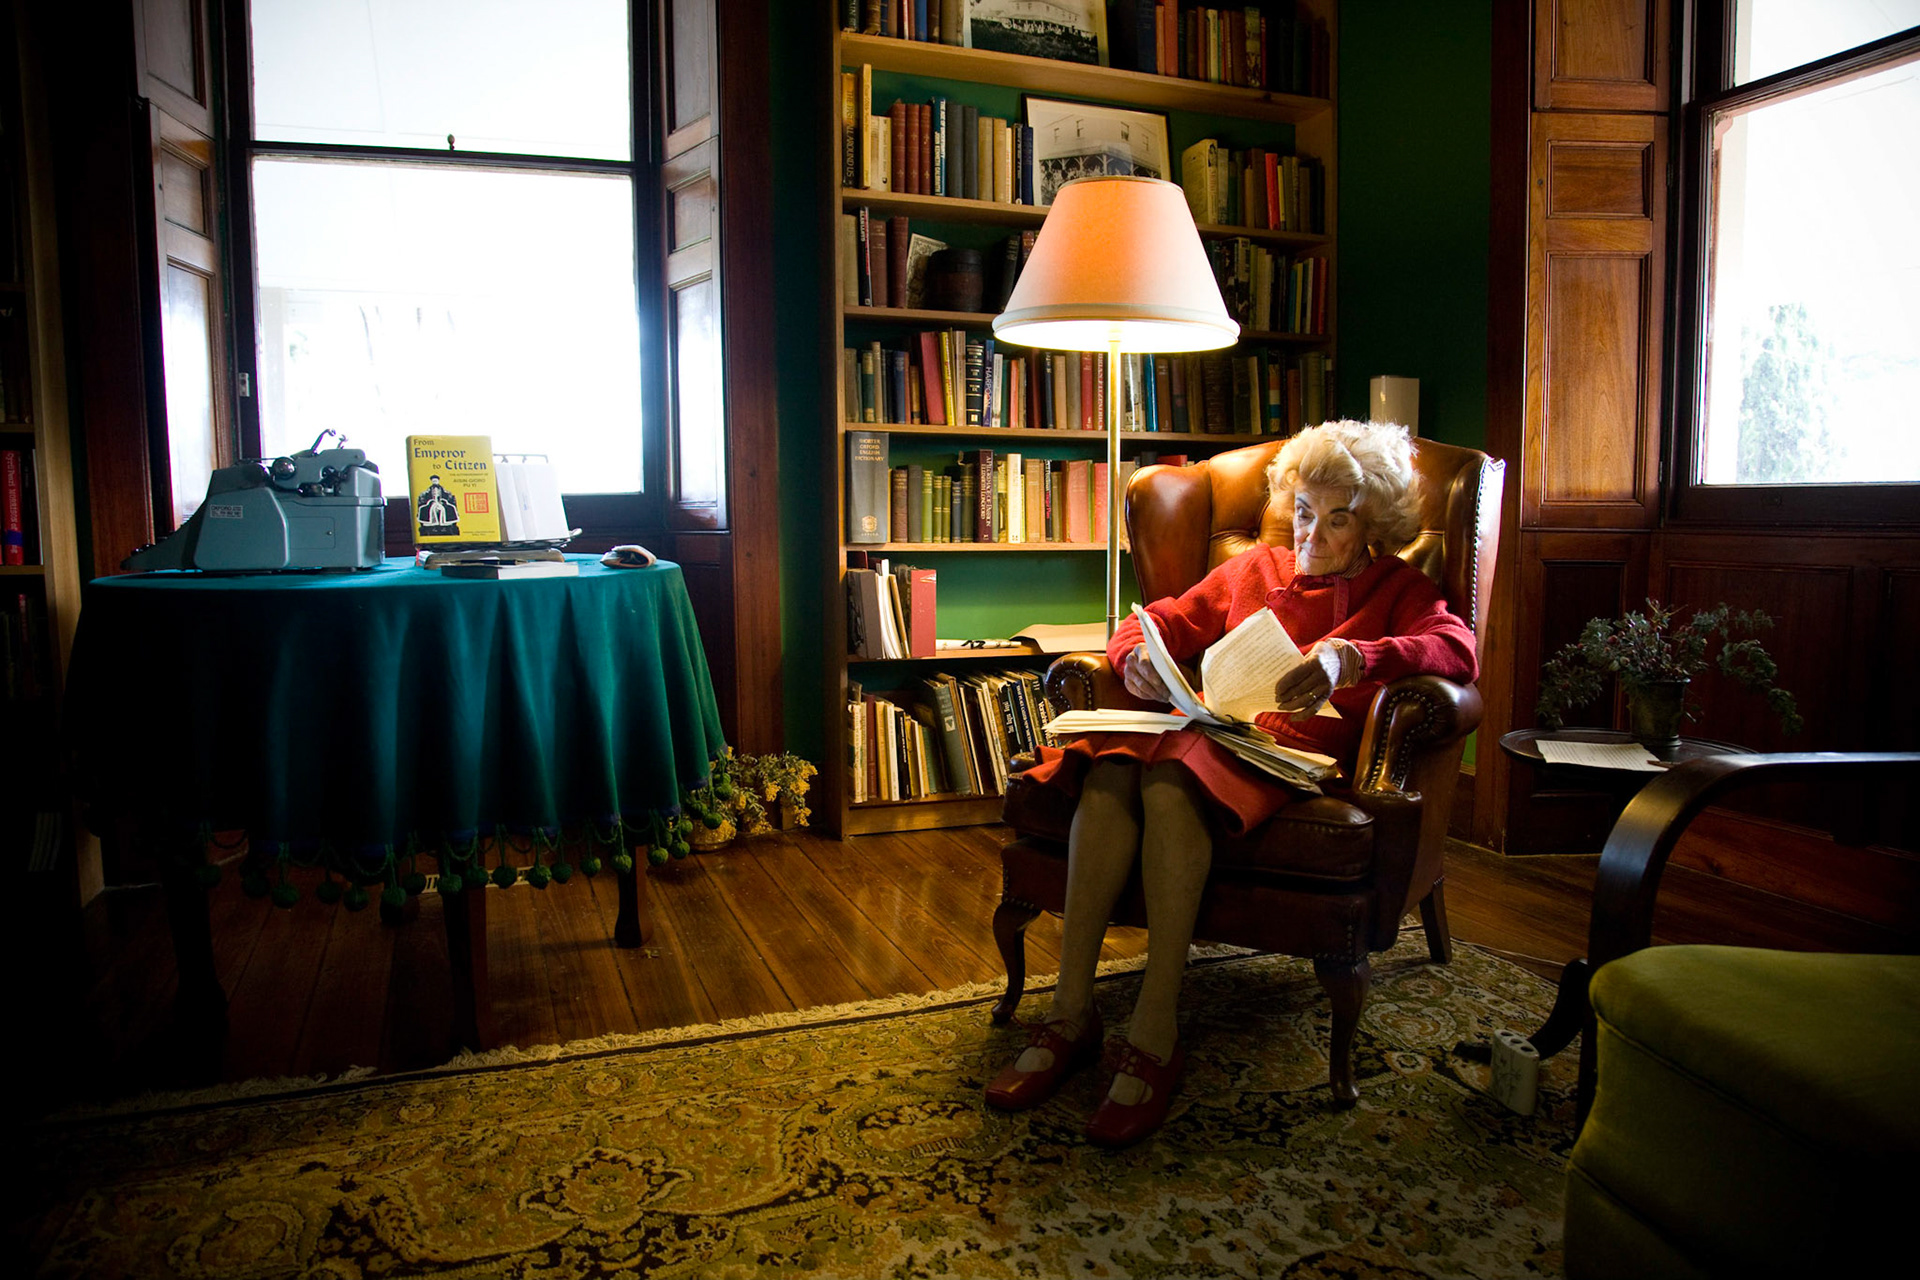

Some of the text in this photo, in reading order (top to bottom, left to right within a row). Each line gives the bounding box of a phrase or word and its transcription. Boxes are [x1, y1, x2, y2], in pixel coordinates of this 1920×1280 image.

[847, 167, 854, 177] US
[415, 448, 466, 459] Emperor
[445, 460, 487, 470] Citizen
